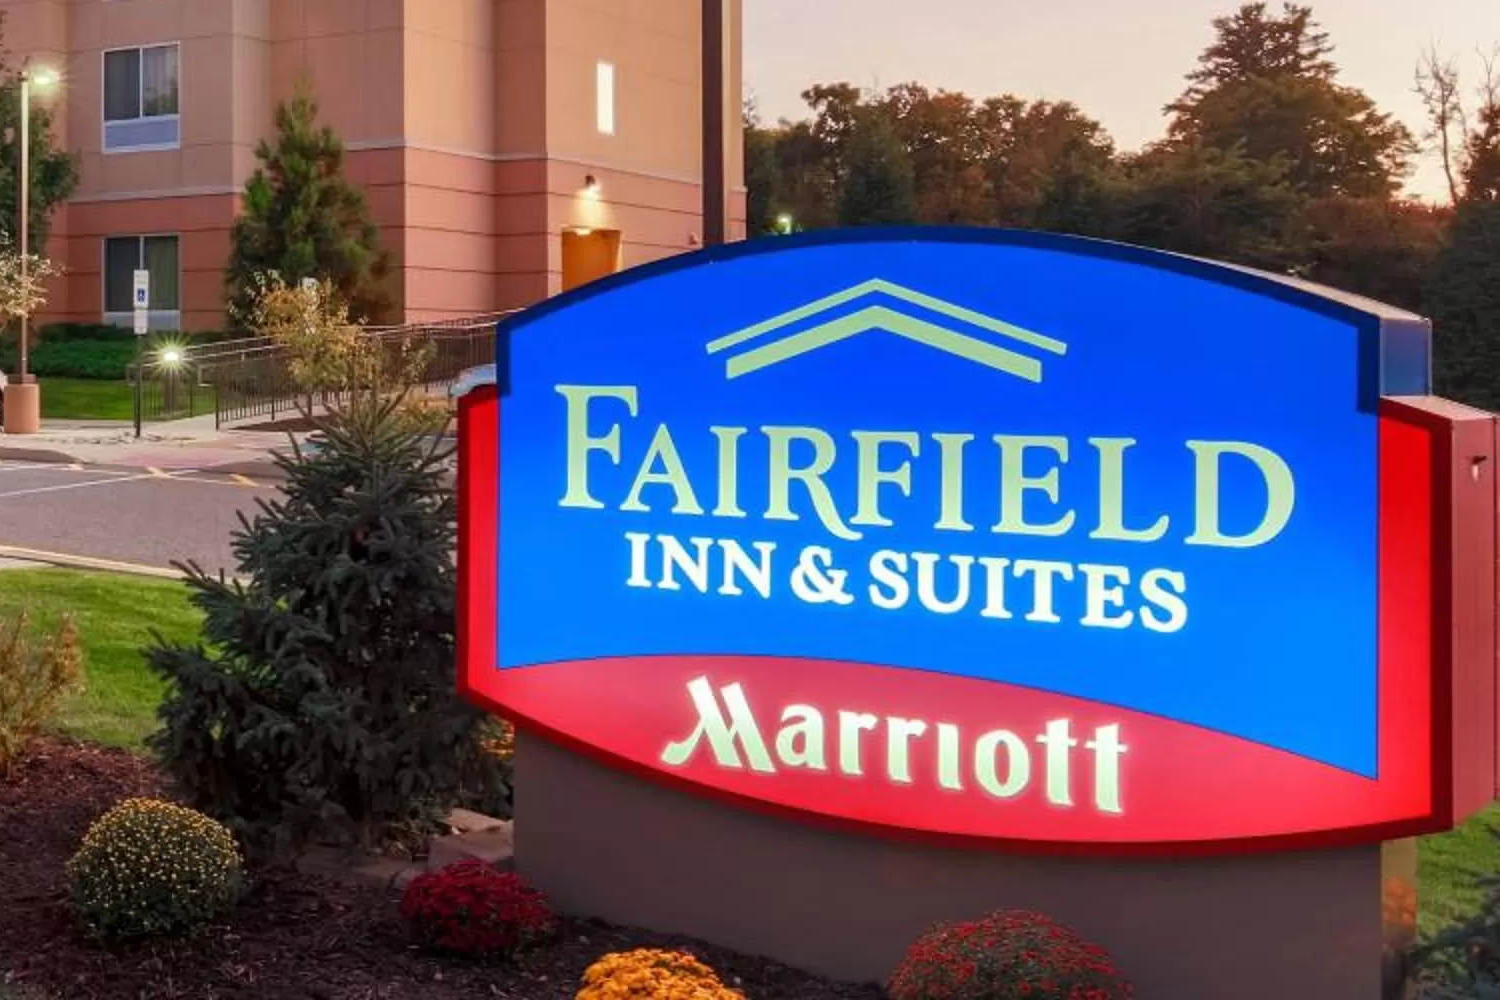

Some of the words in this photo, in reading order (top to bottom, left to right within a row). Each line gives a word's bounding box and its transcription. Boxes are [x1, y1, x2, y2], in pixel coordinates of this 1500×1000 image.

[554, 384, 1296, 549] FAIRFIELD
[624, 531, 778, 600] INN
[789, 544, 855, 606] &
[867, 548, 1189, 634] SUITES
[659, 674, 1130, 815] Marriott
